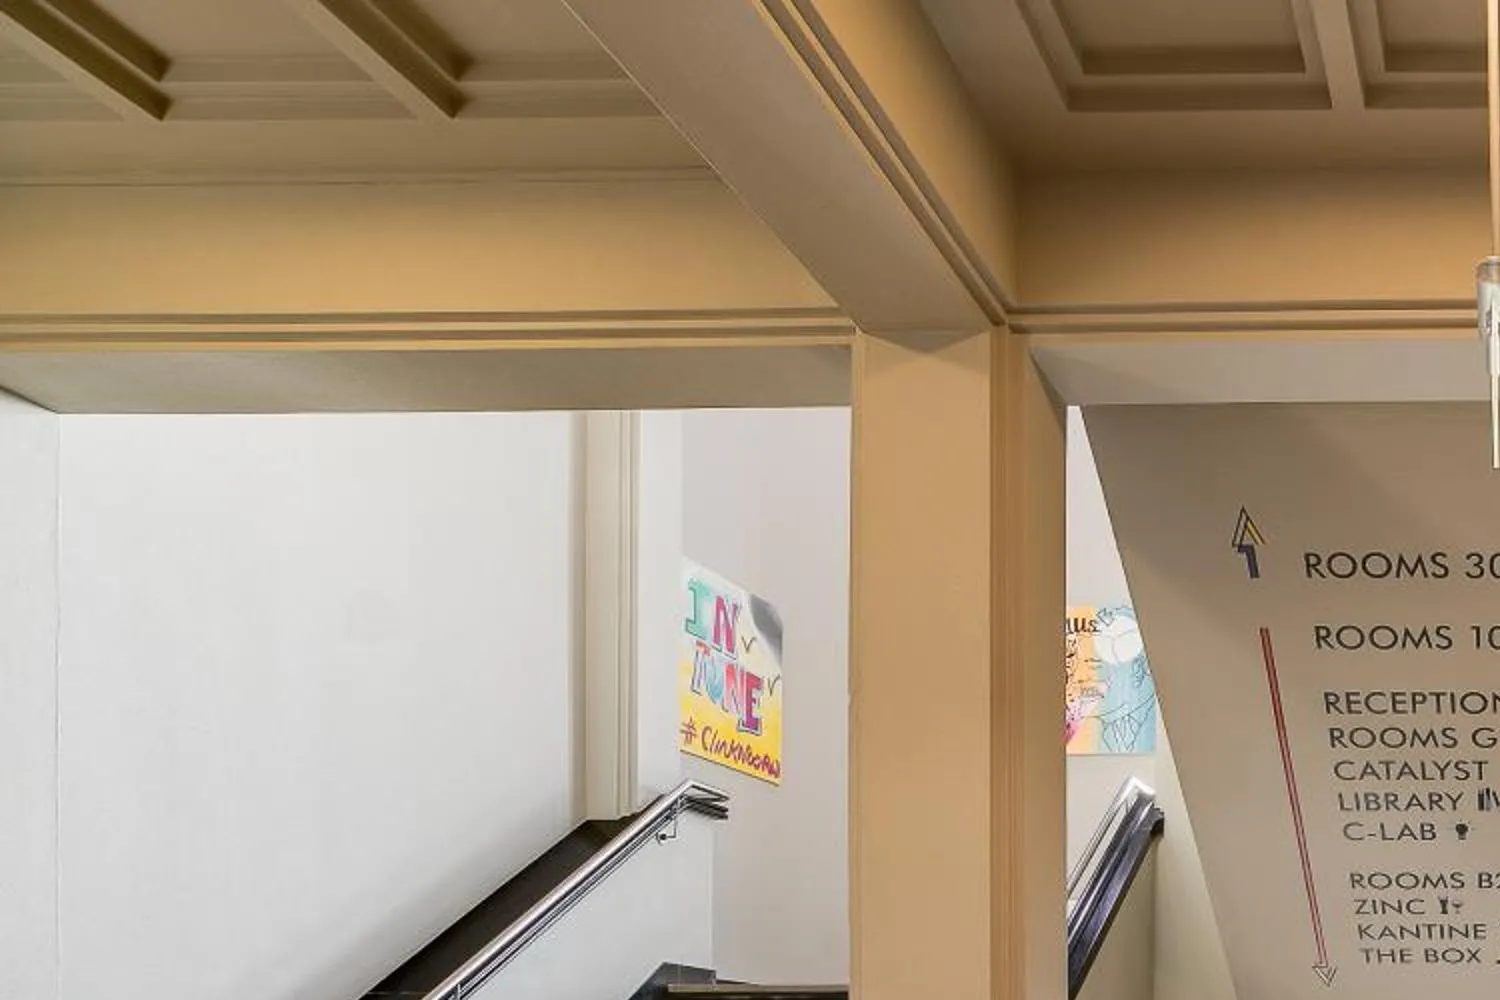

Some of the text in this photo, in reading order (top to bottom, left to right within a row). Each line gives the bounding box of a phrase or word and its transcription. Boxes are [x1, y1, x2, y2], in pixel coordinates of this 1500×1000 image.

[1304, 552, 1450, 579] ROOMS
[1313, 625, 1454, 650] ROOMS
[690, 640, 764, 737] TUNE
[1329, 727, 1459, 749] ROOMS
[1334, 760, 1489, 781] CATALYST
[1338, 791, 1464, 812] LIBRARY
[1343, 822, 1437, 841] C-LAB
[1349, 872, 1466, 889] ROOMS
[1354, 898, 1426, 915] ZINC
[1357, 923, 1487, 940] KANTINE
[1360, 948, 1481, 964] THE BOX
